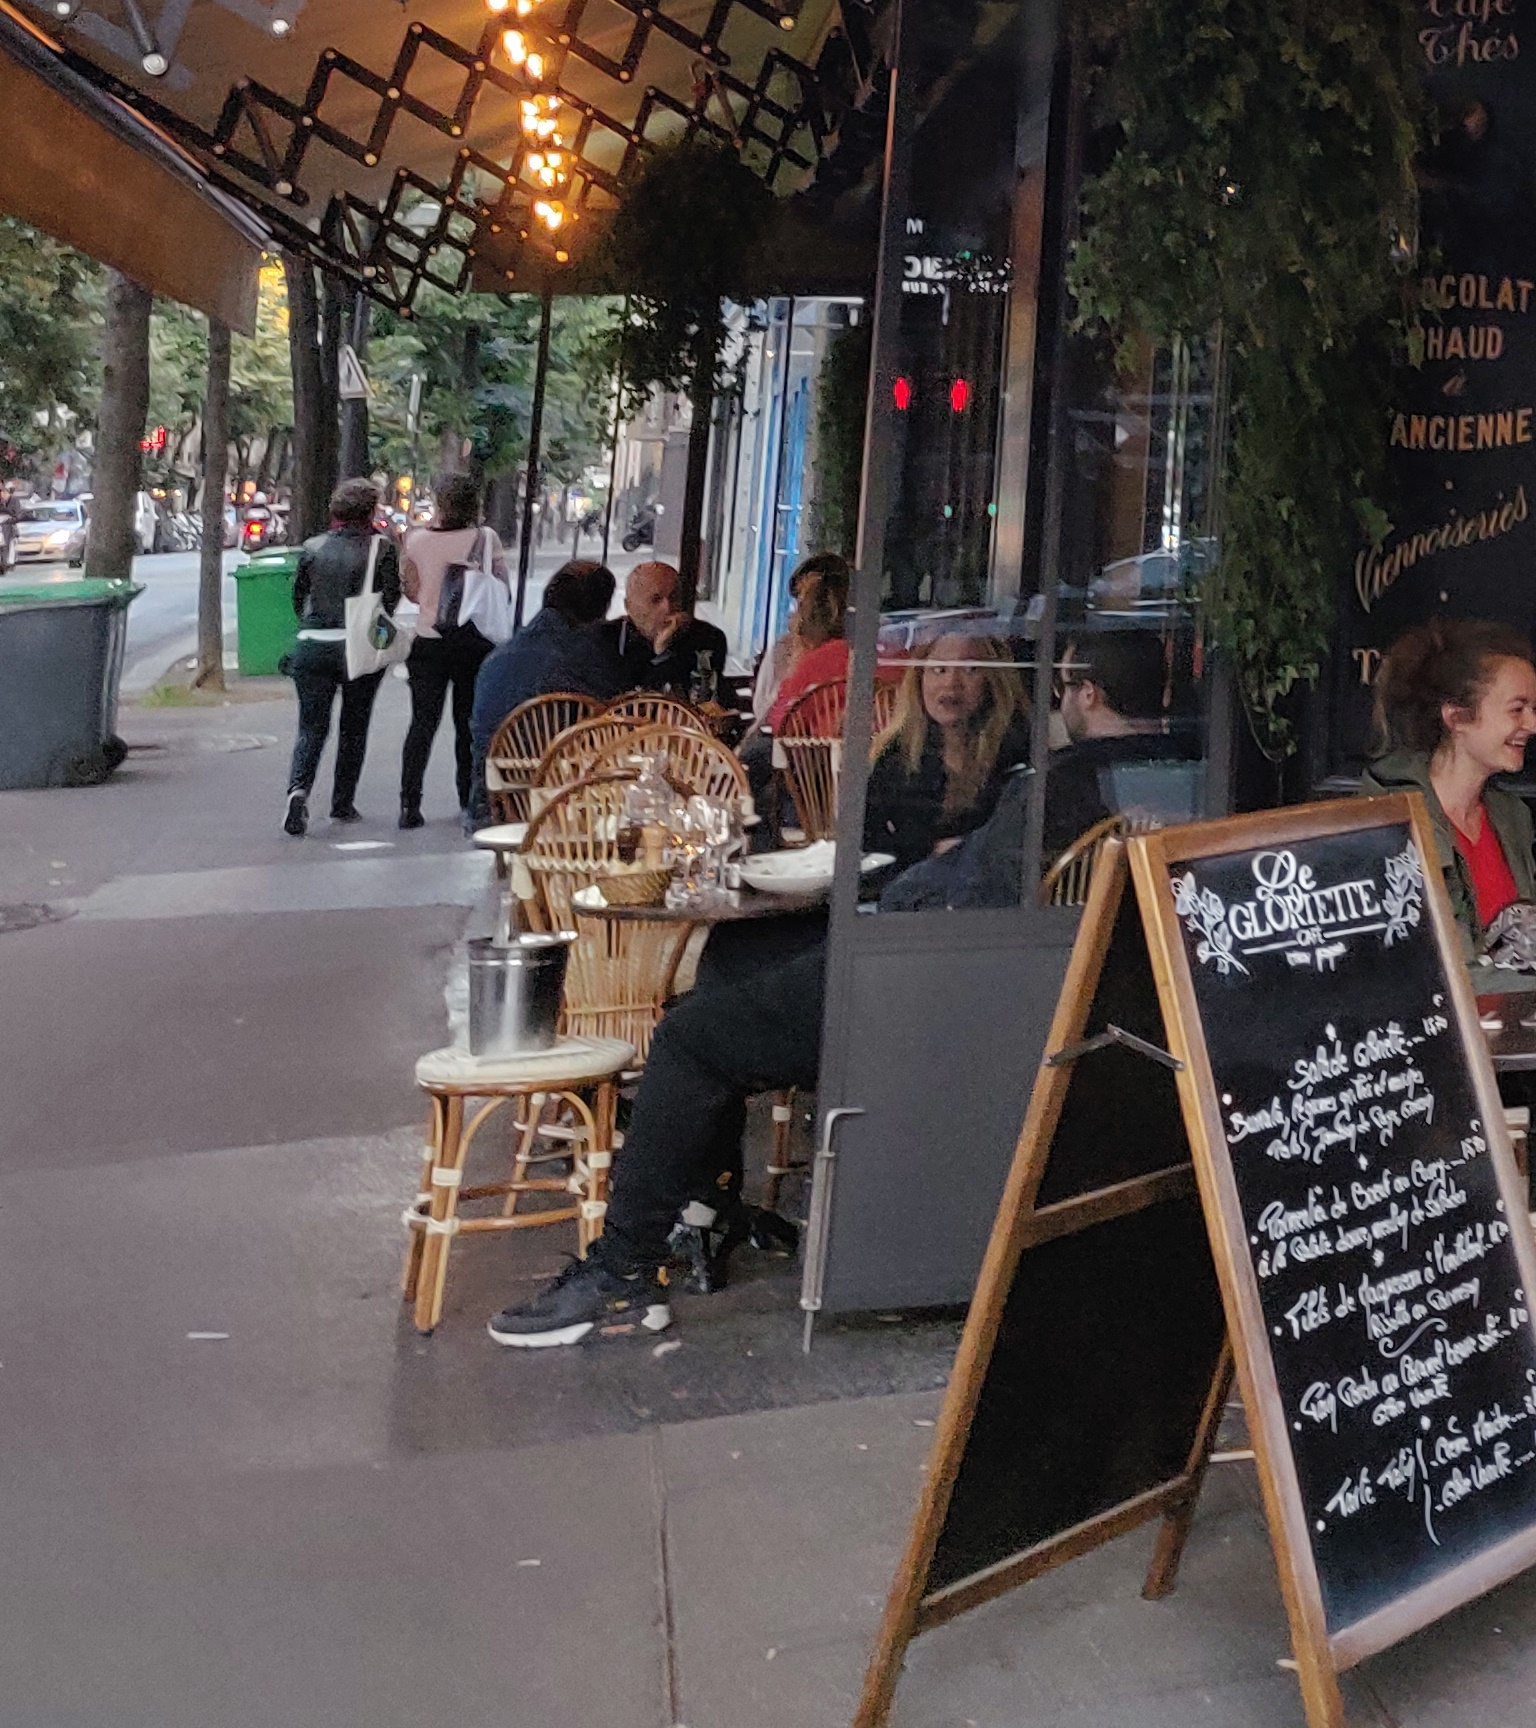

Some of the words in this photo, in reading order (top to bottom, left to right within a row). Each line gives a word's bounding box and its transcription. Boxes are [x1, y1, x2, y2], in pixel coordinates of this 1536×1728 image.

[1421, 273, 1534, 314] OCOLAT
[1427, 324, 1504, 361] HAUD
[1228, 879, 1382, 941] GLORIETTE
